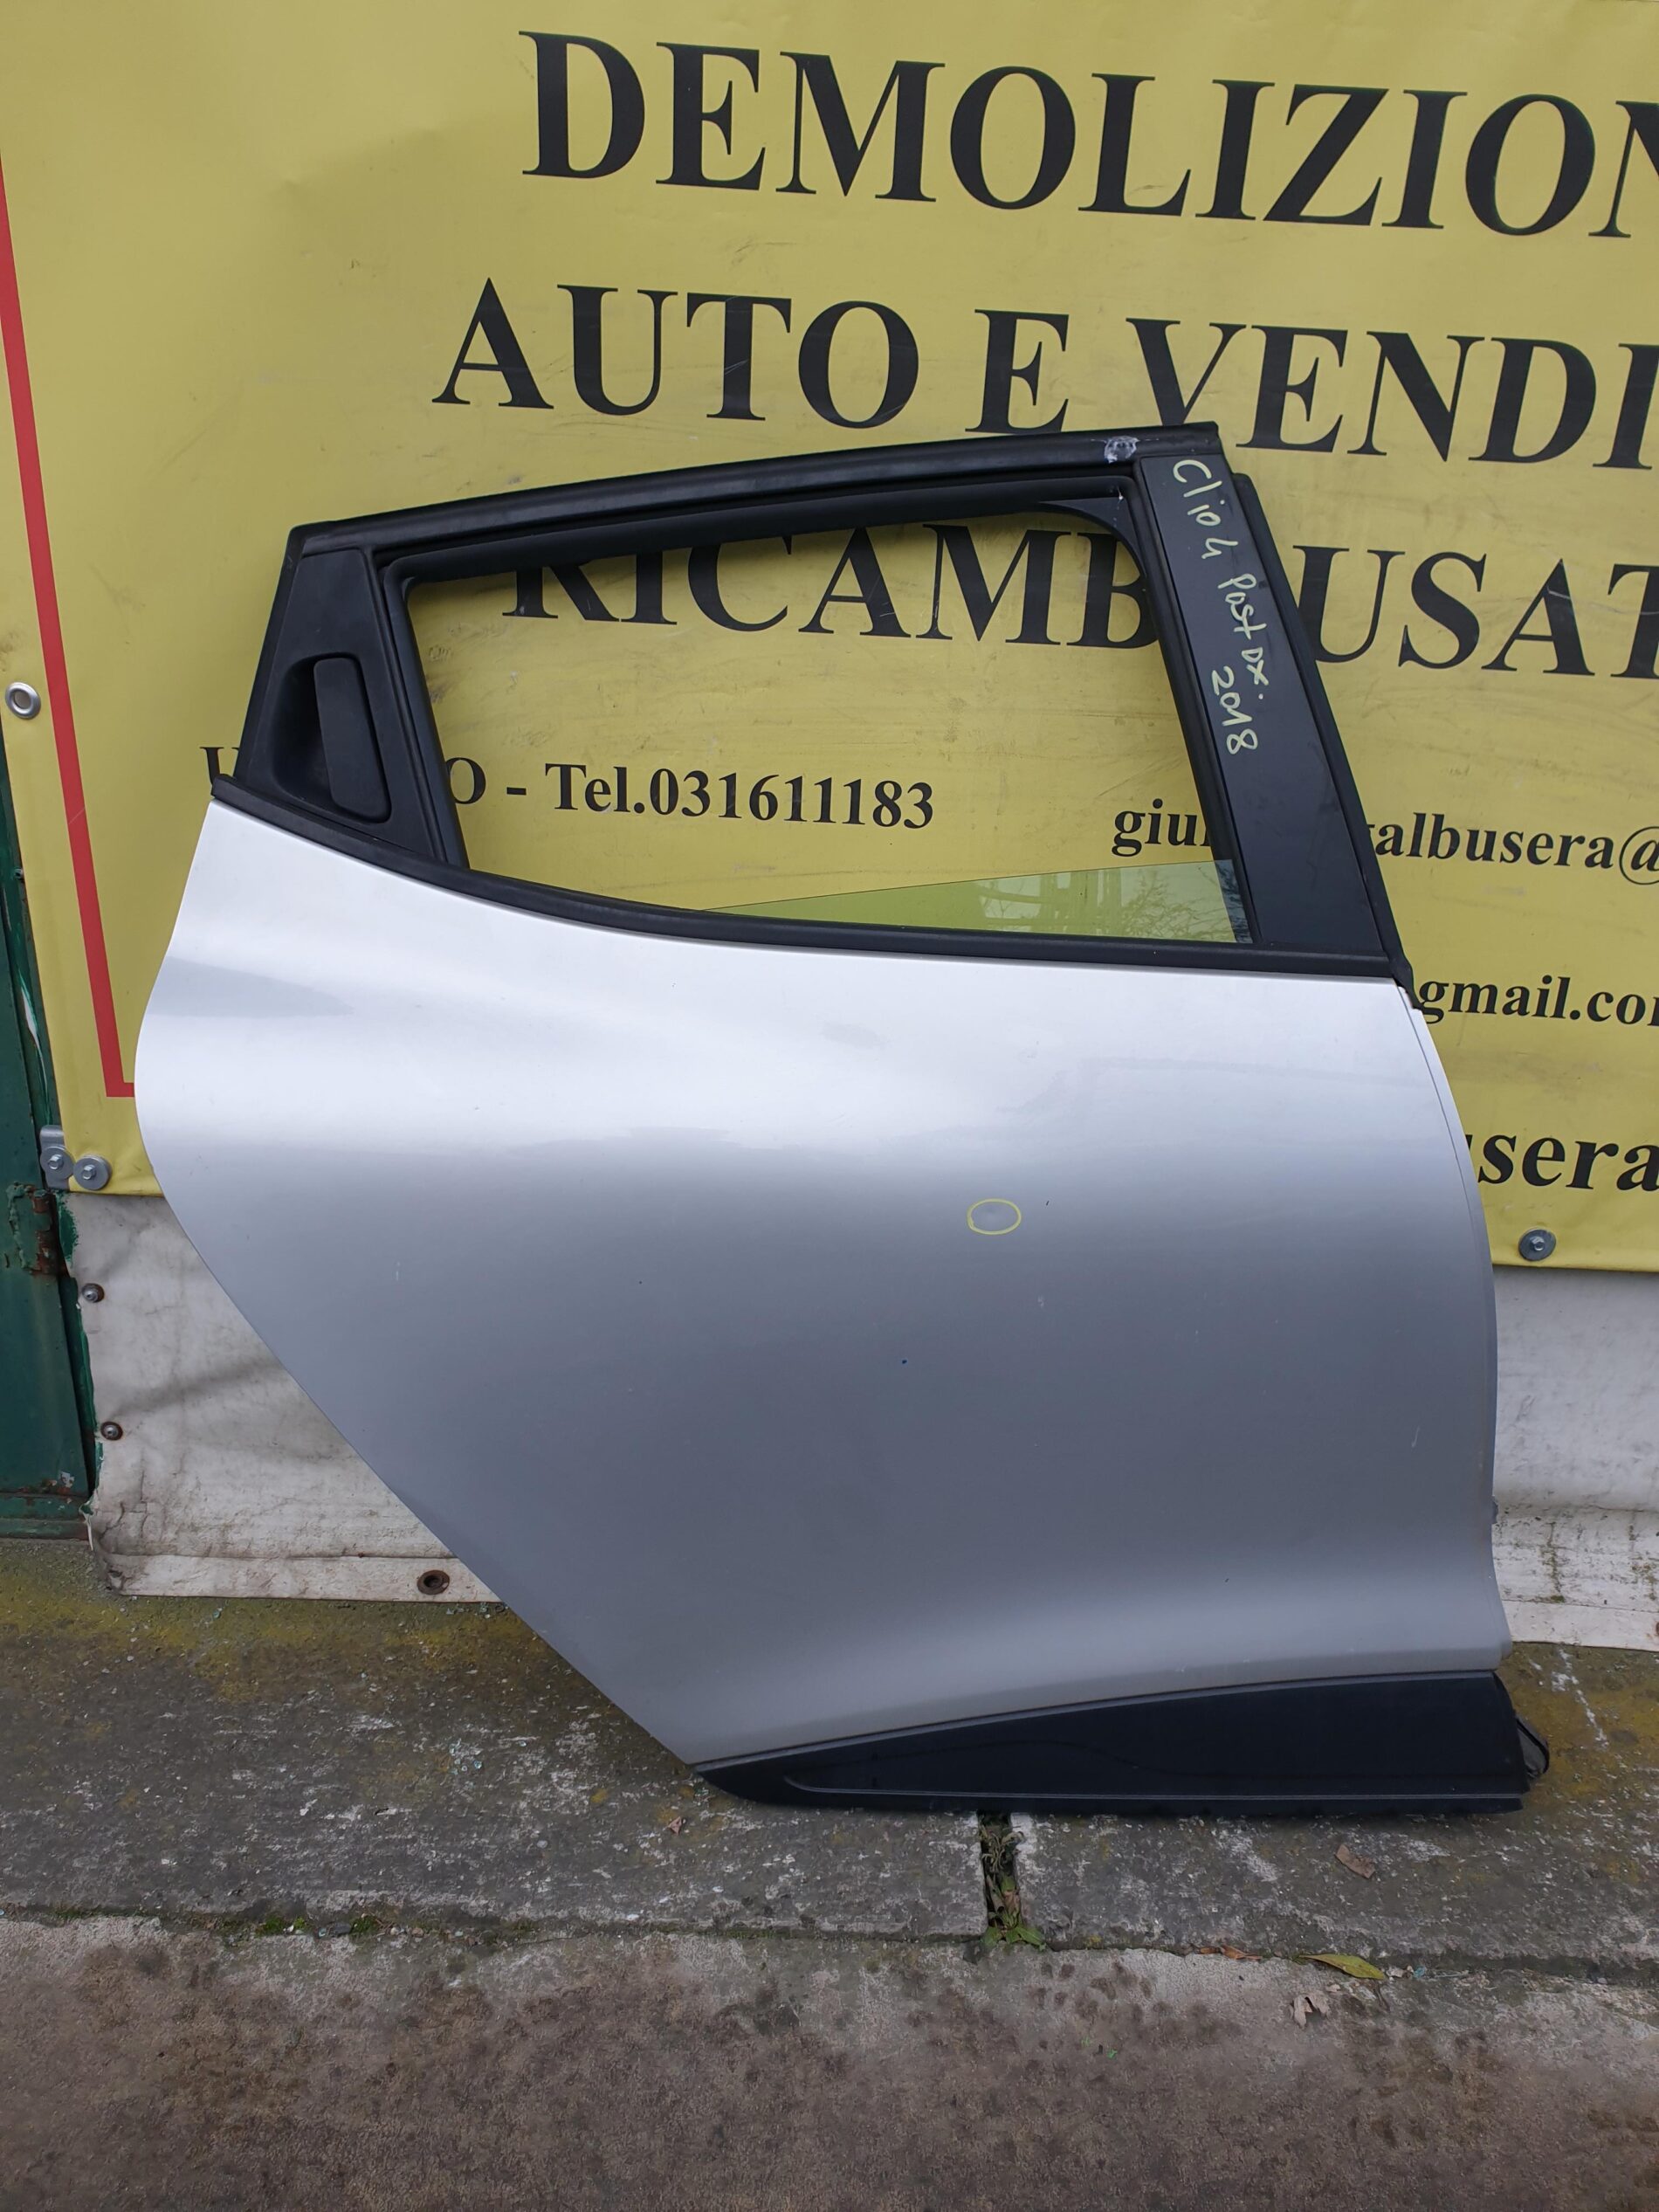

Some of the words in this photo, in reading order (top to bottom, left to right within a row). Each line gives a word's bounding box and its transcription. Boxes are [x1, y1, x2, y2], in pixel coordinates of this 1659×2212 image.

[431, 277, 919, 430] AUTO
[965, 308, 1070, 435] E
[1126, 317, 1659, 471] VENDI
[1172, 458, 1226, 527] Clio
[1211, 665, 1258, 755] 2018
[544, 762, 934, 830] Tel.031611183
[1418, 974, 1659, 1027] gmail.co
[1464, 1134, 1659, 1192] sera
